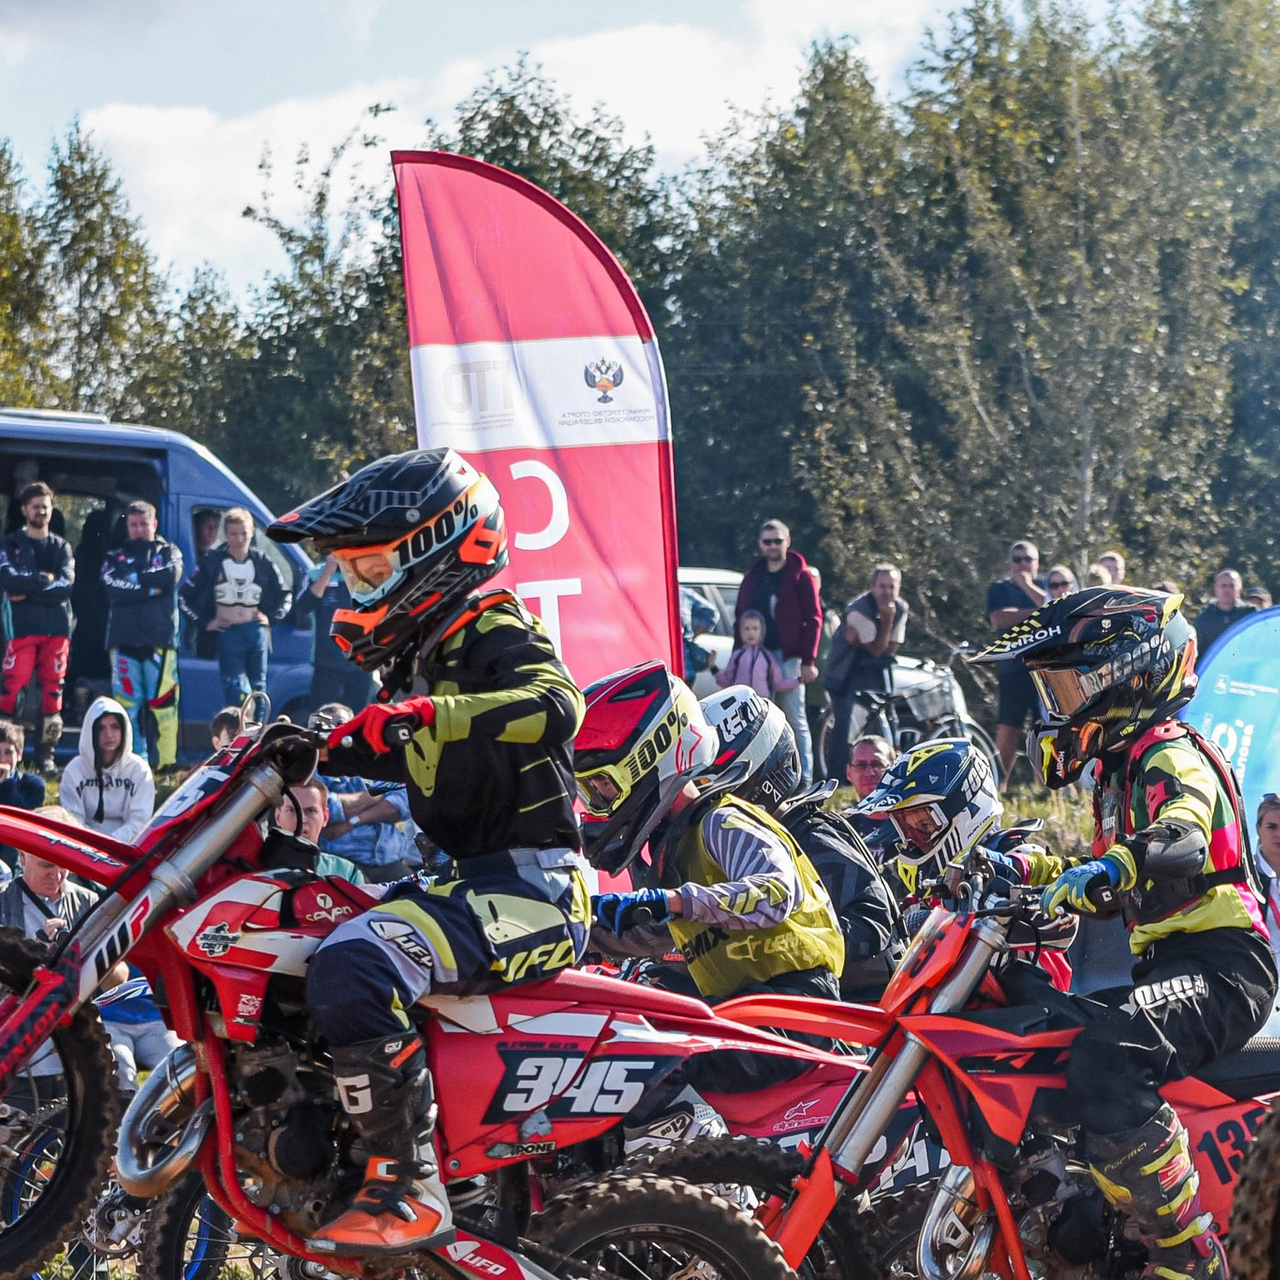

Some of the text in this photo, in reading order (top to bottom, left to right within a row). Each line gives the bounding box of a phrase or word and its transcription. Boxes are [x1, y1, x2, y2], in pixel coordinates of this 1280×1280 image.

[392, 494, 479, 567] 100%
[626, 710, 690, 785] 100%
[502, 1056, 655, 1114] 345
[509, 1140, 556, 1157] PONE
[462, 1252, 507, 1276] UFO
